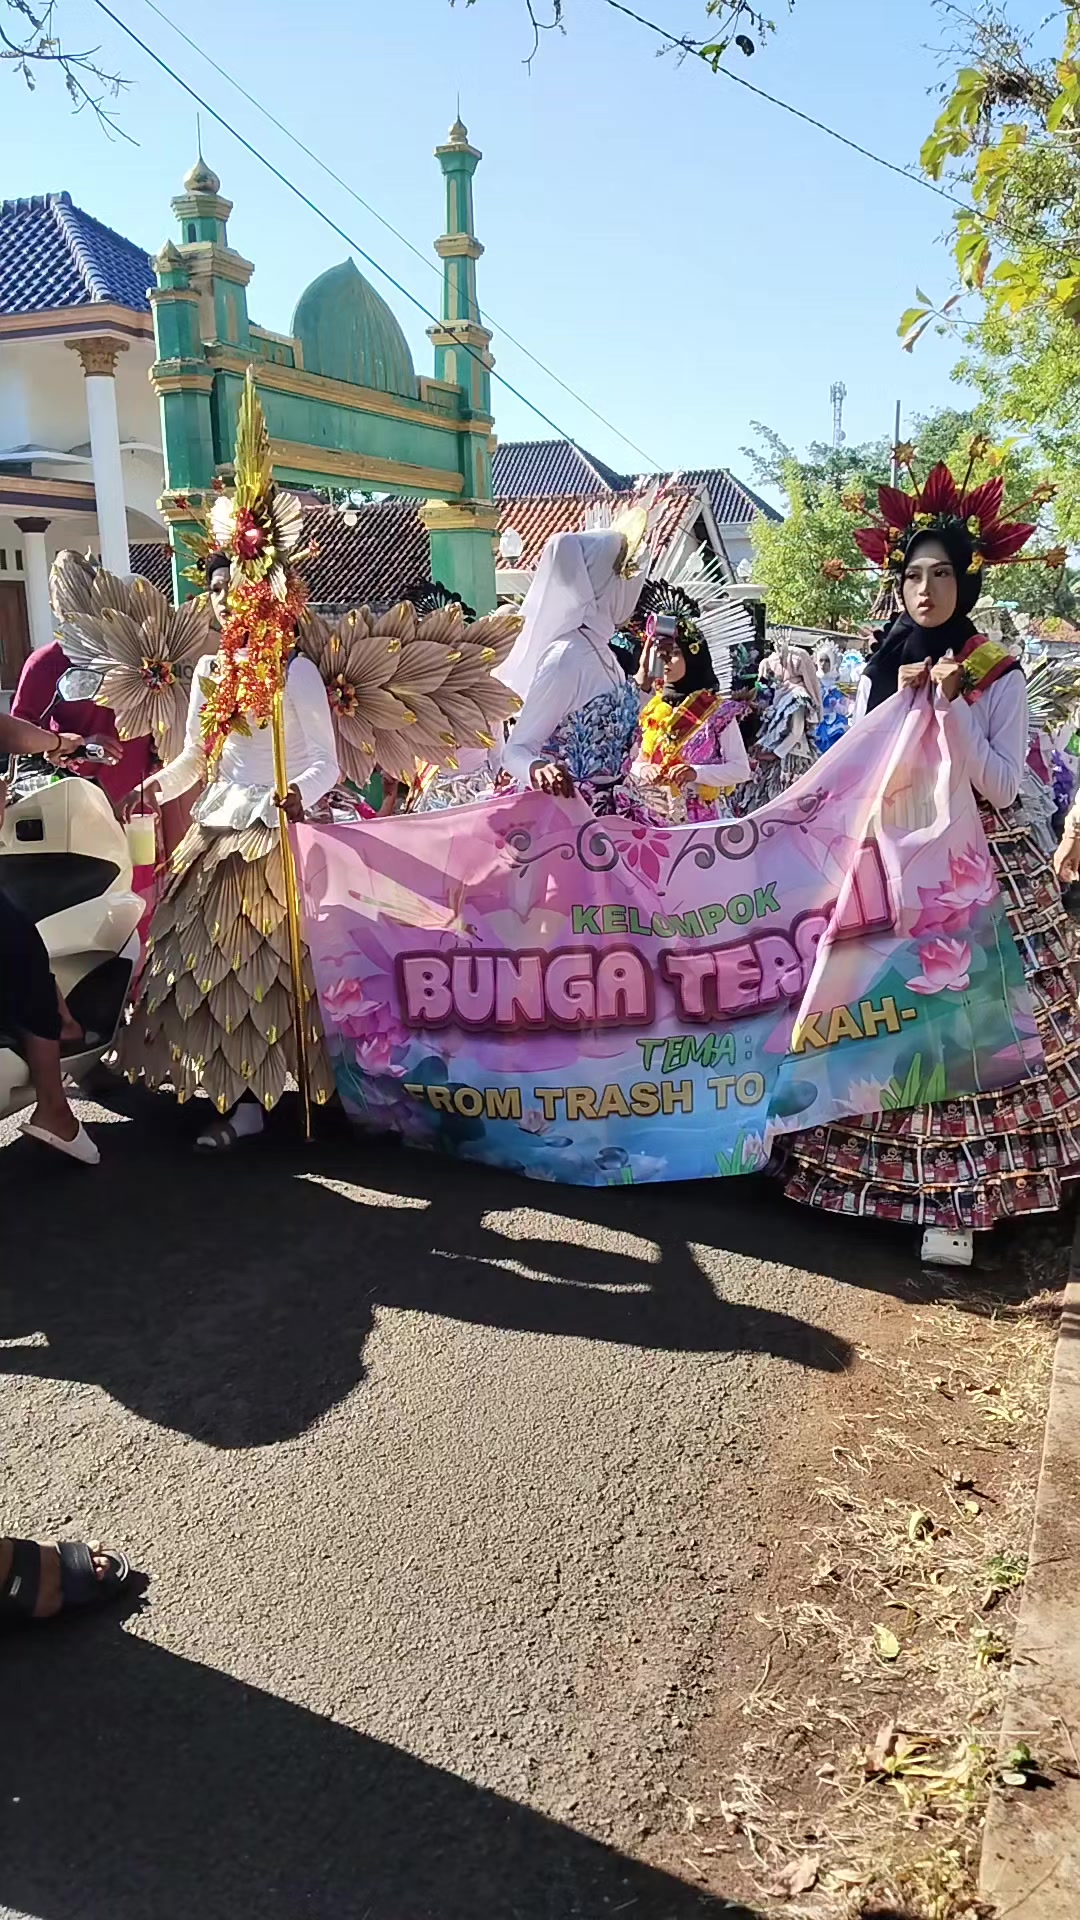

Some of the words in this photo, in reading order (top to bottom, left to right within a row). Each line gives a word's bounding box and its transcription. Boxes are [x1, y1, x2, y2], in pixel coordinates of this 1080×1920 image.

[571, 881, 781, 938] KELOMPOK
[397, 948, 652, 1028] BUNGA
[403, 1083, 522, 1119] FROM
[534, 1079, 694, 1120] TRASH
[708, 1071, 766, 1109] TO
